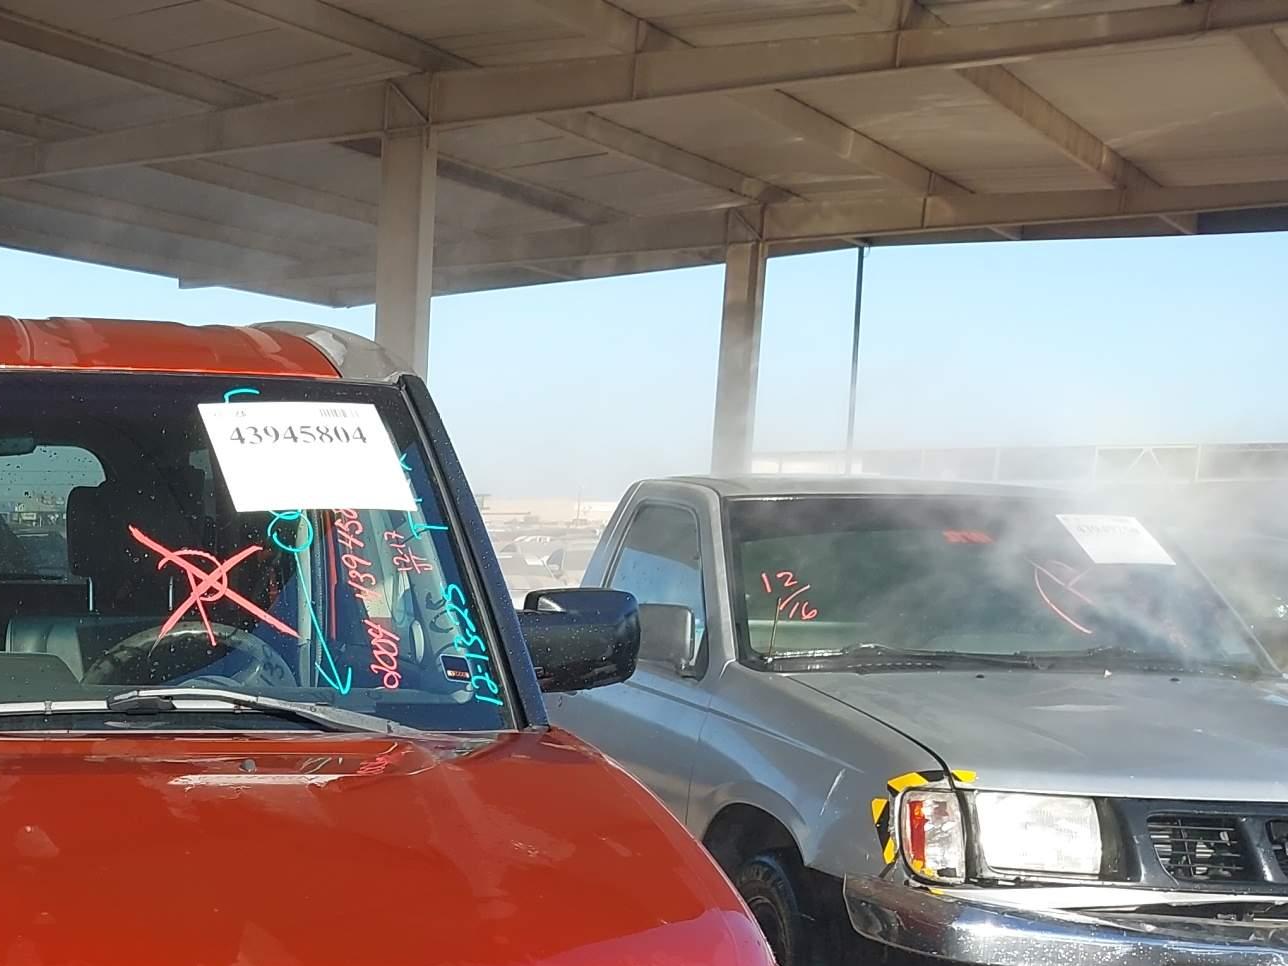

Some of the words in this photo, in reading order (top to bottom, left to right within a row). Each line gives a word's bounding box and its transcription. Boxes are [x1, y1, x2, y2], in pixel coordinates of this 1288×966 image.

[229, 425, 368, 444] 43945804
[761, 571, 818, 620] 12/16
[363, 619, 402, 690] 2004
